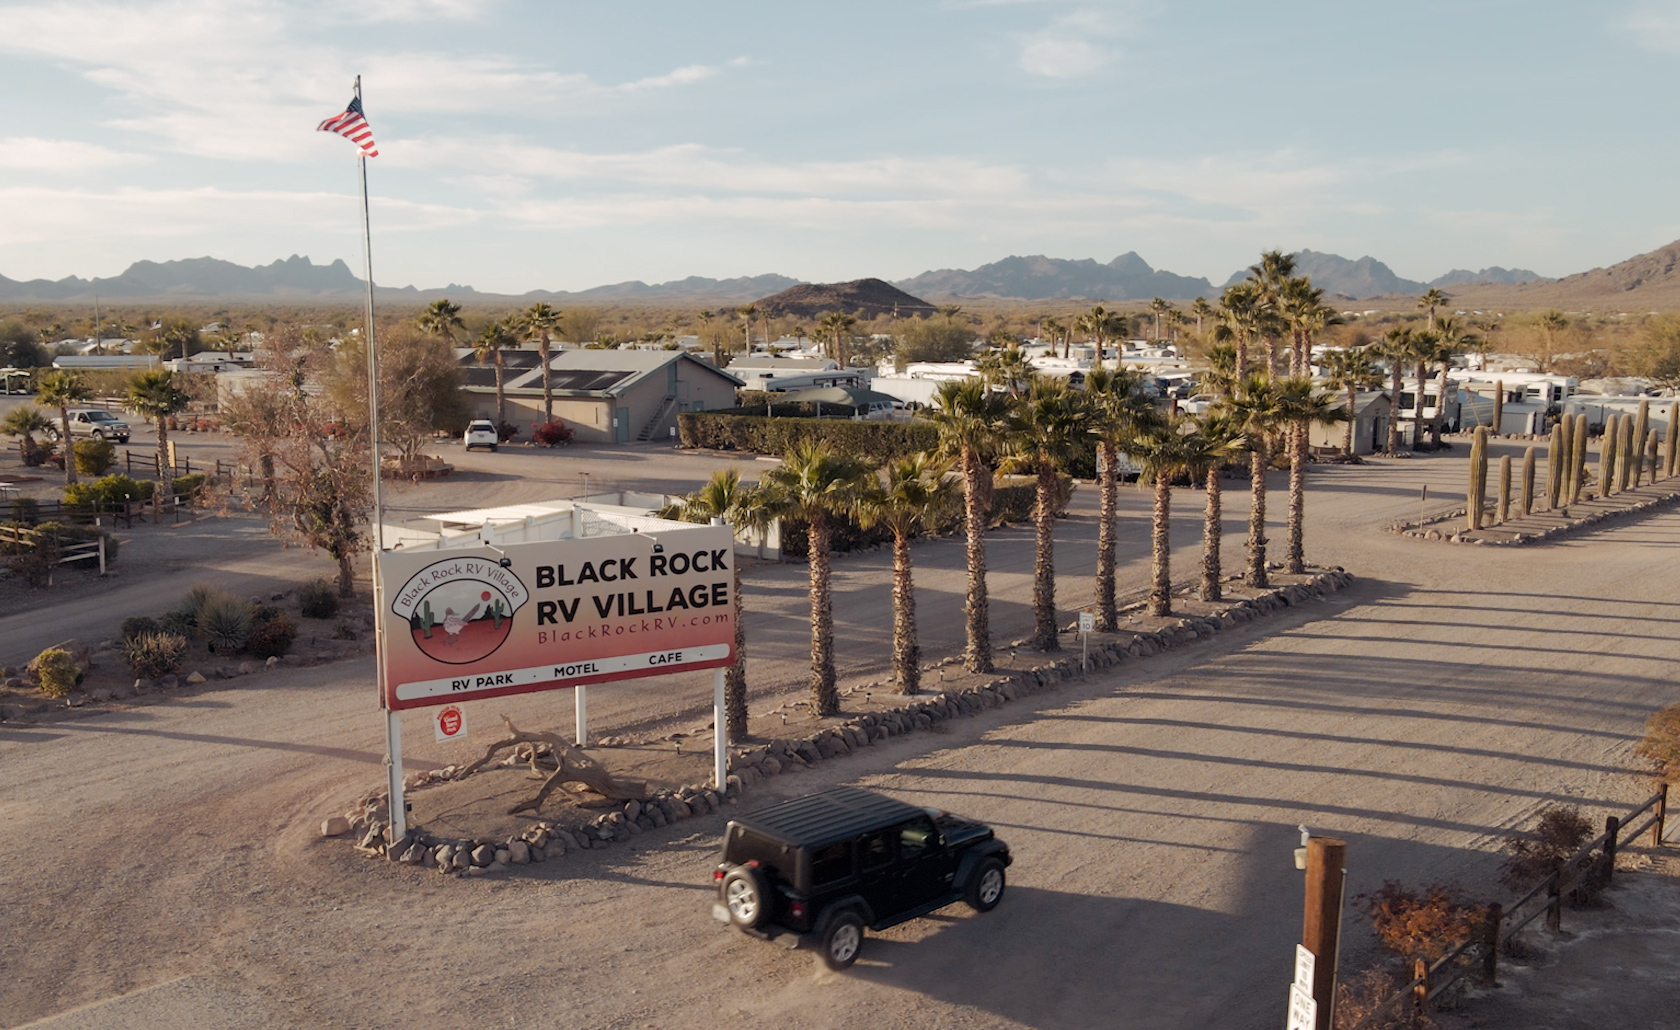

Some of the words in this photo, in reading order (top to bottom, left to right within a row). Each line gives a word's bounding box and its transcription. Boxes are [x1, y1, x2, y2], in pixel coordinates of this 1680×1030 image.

[401, 577, 431, 607] Black
[431, 563, 462, 581] Rock
[466, 563, 484, 574] RV
[487, 566, 519, 599] Village
[536, 557, 638, 588] BLACK
[650, 549, 728, 577] ROCK
[537, 597, 581, 626] RV
[592, 582, 728, 619] VILLAGE
[538, 613, 729, 644] BlackRockRV.com
[452, 678, 471, 691] RV
[476, 674, 514, 688] PARK
[554, 663, 600, 678] MOTEL
[648, 651, 683, 666] CAFE
[1294, 1008, 1310, 1028] WAY
[1295, 993, 1311, 1015] ONE
